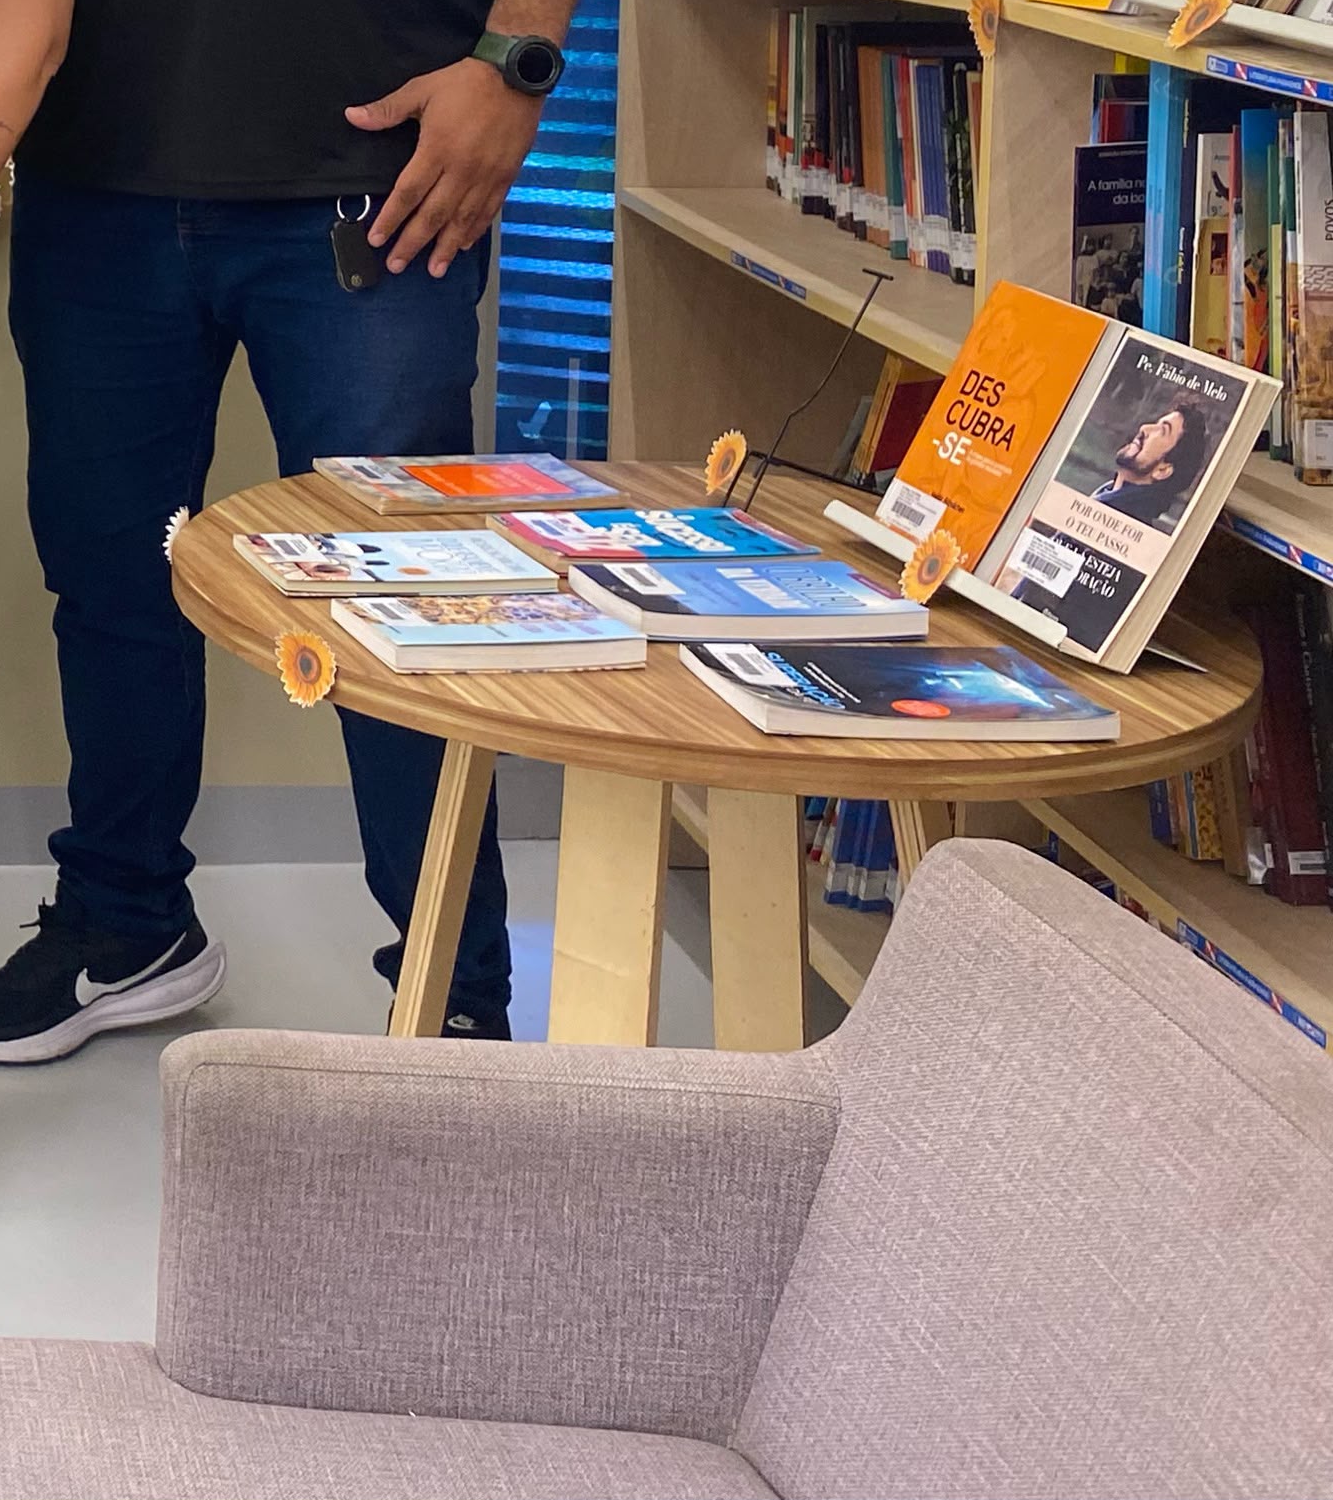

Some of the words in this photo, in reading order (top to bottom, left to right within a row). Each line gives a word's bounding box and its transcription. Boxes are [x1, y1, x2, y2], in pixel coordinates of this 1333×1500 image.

[1088, 180, 1096, 191] A
[959, 369, 1005, 407] DES
[1155, 362, 1186, 385] Fábio
[1186, 375, 1201, 390] de
[1202, 380, 1227, 402] Melo
[946, 400, 1016, 452] CUBRA
[1065, 517, 1074, 528] O
[1075, 522, 1094, 538] TEU
[1070, 500, 1092, 518] POR
[1093, 510, 1121, 533] ONDE
[1122, 523, 1144, 543] FOR
[1085, 555, 1121, 582] ESTEJA
